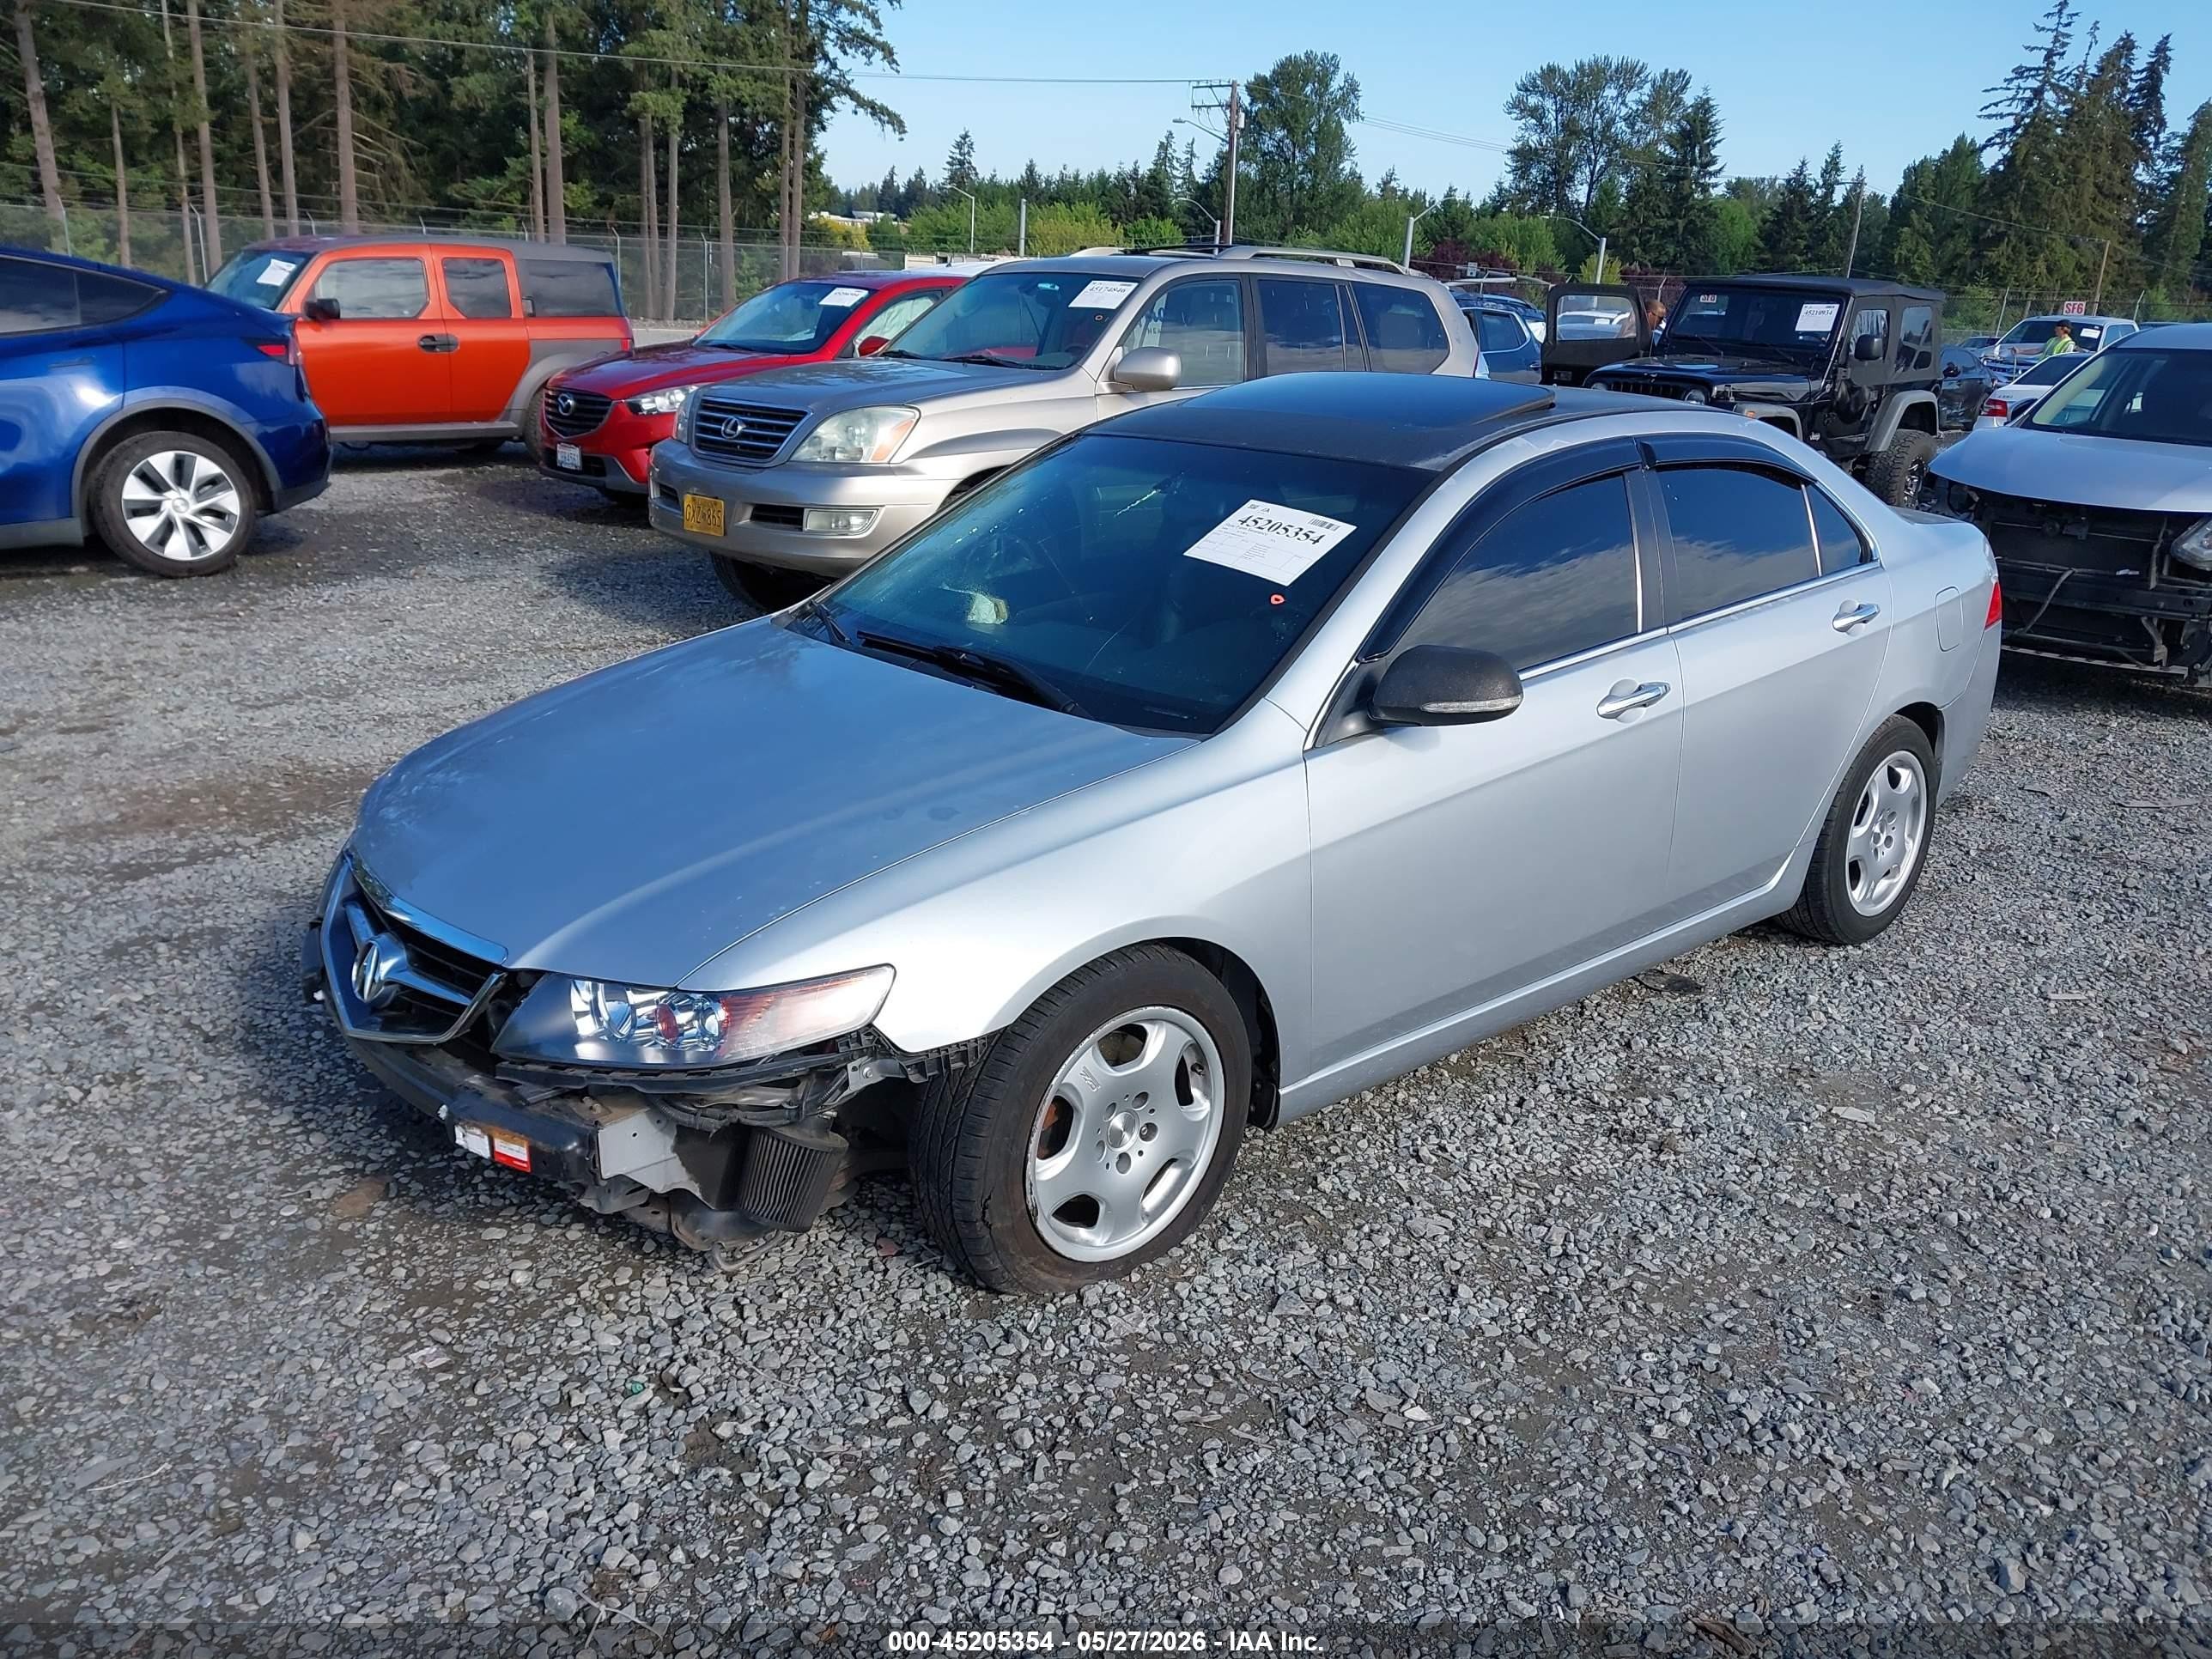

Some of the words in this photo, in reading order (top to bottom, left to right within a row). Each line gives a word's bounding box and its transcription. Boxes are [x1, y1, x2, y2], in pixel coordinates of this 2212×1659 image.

[2065, 302, 2084, 314] SF6
[707, 507, 721, 527] 865
[1237, 515, 1325, 545] 45205354
